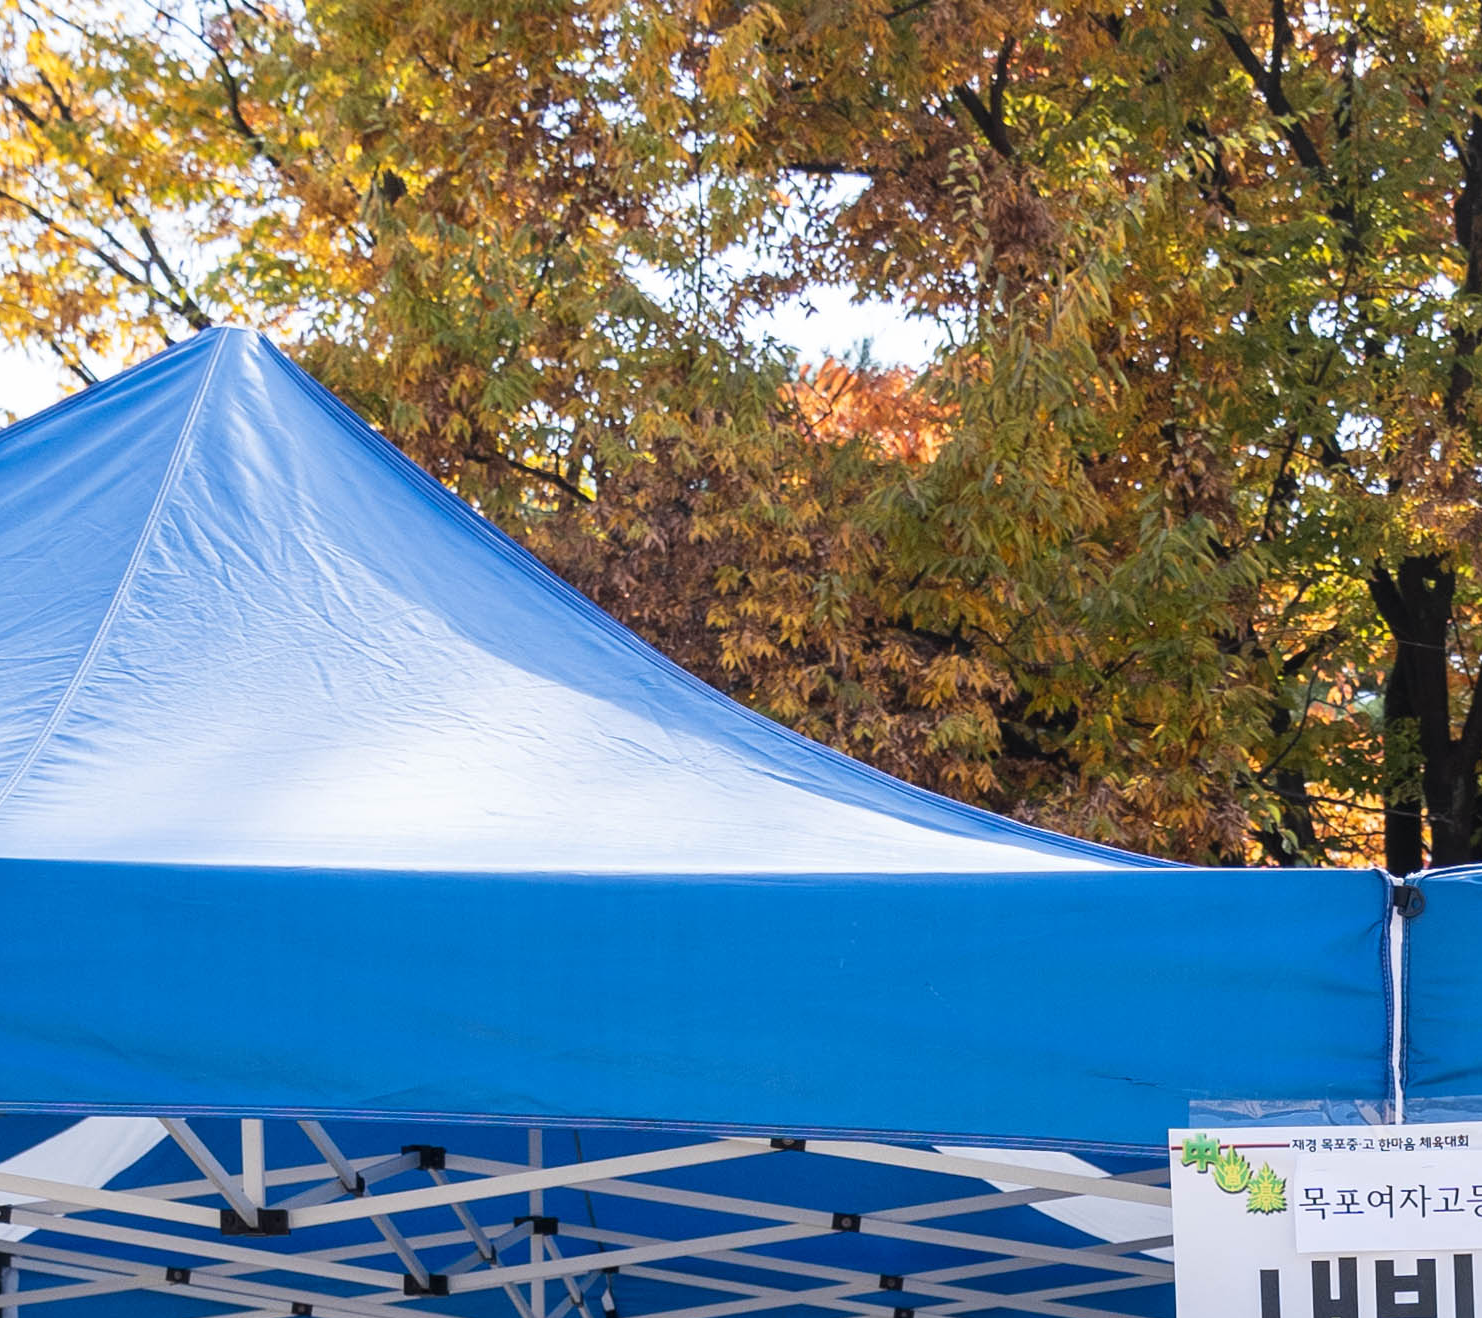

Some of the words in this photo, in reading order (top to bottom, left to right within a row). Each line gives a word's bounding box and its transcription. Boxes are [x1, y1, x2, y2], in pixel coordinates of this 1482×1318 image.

[1292, 1139, 1318, 1152] 재경
[1378, 1138, 1417, 1151] 한마음
[1419, 1135, 1469, 1149] 체육대회
